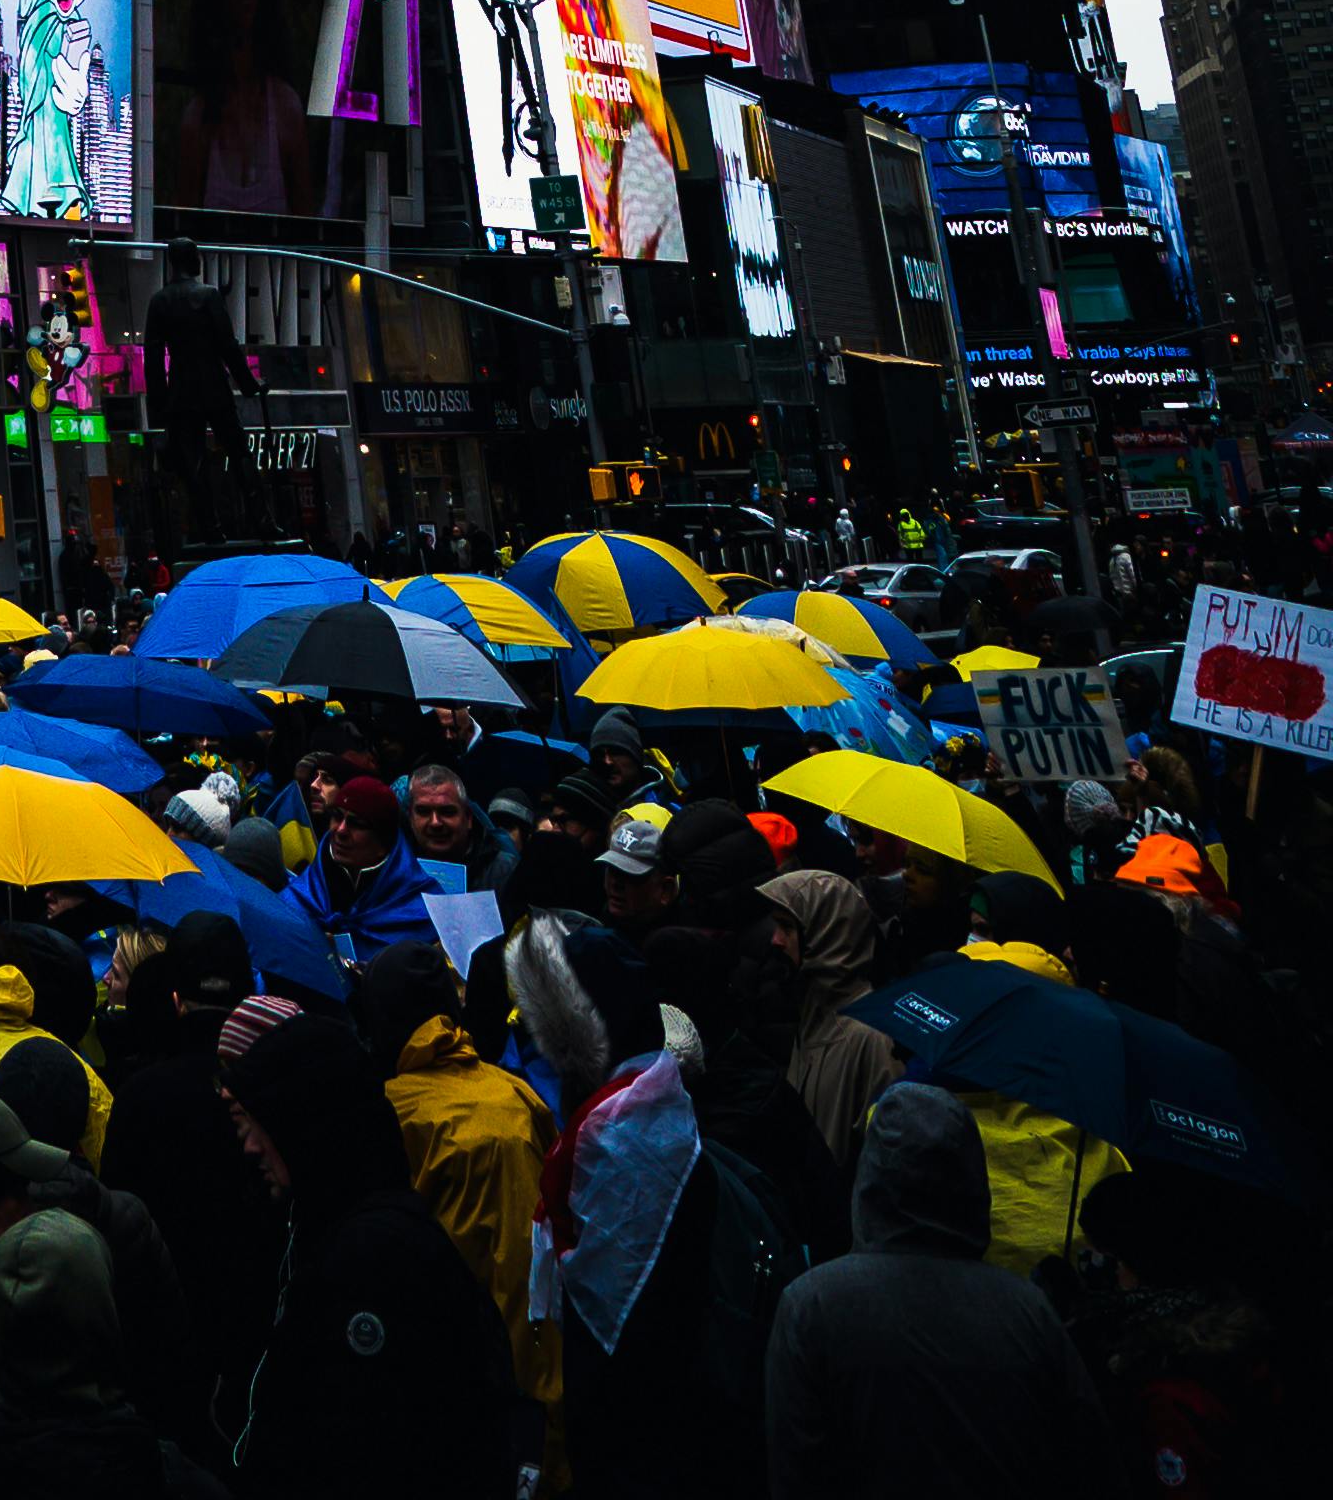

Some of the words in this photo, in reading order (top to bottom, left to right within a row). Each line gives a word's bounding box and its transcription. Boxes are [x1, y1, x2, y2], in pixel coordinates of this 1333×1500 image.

[562, 33, 589, 61] ARE
[587, 36, 648, 70] LIMITLESS
[548, 181, 562, 193] TO
[946, 219, 1009, 237] WATCH
[1090, 221, 1132, 238] World
[986, 346, 1033, 362] threat
[1124, 344, 1157, 358] says
[1090, 368, 1159, 388] Cowboys
[380, 388, 405, 414] U.S.
[406, 389, 438, 414] POLO
[439, 389, 475, 414] ASSN.
[1030, 408, 1054, 422] ONE
[1061, 405, 1084, 420] WAY
[1204, 592, 1257, 645] PUT
[997, 671, 1103, 726] FUCK
[1193, 697, 1223, 727] HE
[1236, 706, 1255, 733] IS
[1259, 718, 1274, 739] A
[1000, 726, 1116, 778] PUTIN
[1166, 1110, 1239, 1143] octagon
